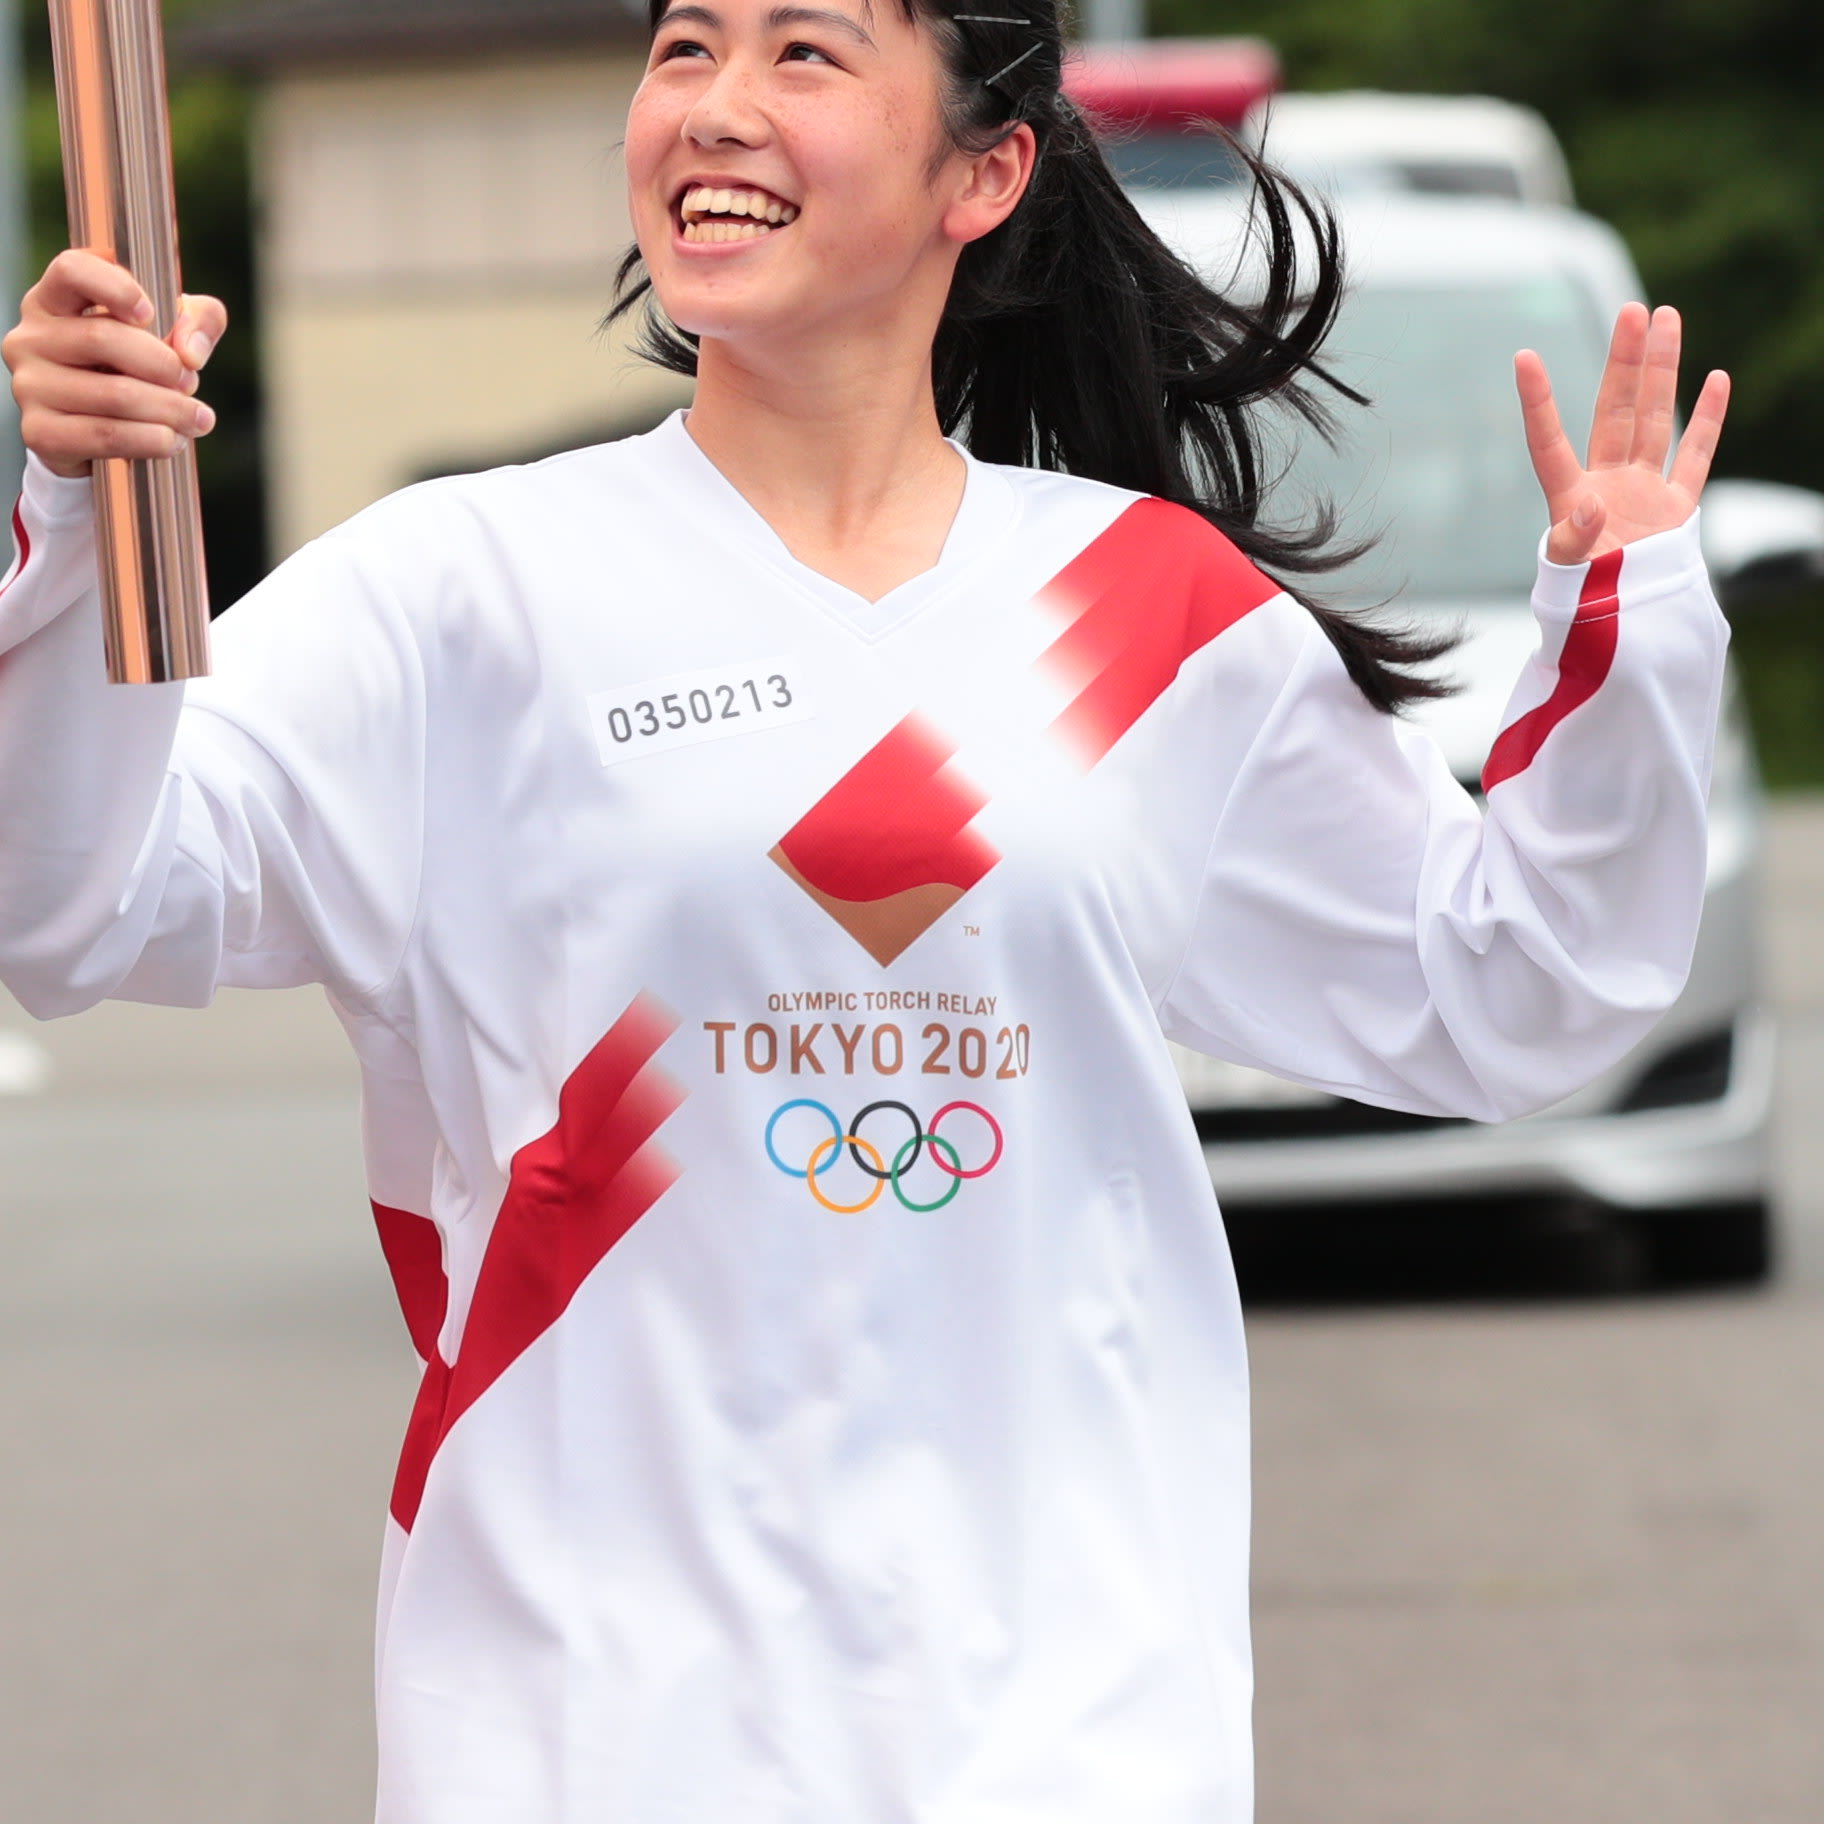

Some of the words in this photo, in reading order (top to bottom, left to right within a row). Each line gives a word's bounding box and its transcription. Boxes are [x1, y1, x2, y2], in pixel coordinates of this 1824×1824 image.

[607, 674, 793, 744] 0350213
[962, 925, 980, 937] TM
[768, 992, 858, 1012] OLYMPIC
[864, 991, 929, 1011] TORCH
[937, 993, 997, 1016] RELAY
[703, 1022, 903, 1075] TOKYO
[921, 1023, 1030, 1080] 2020
